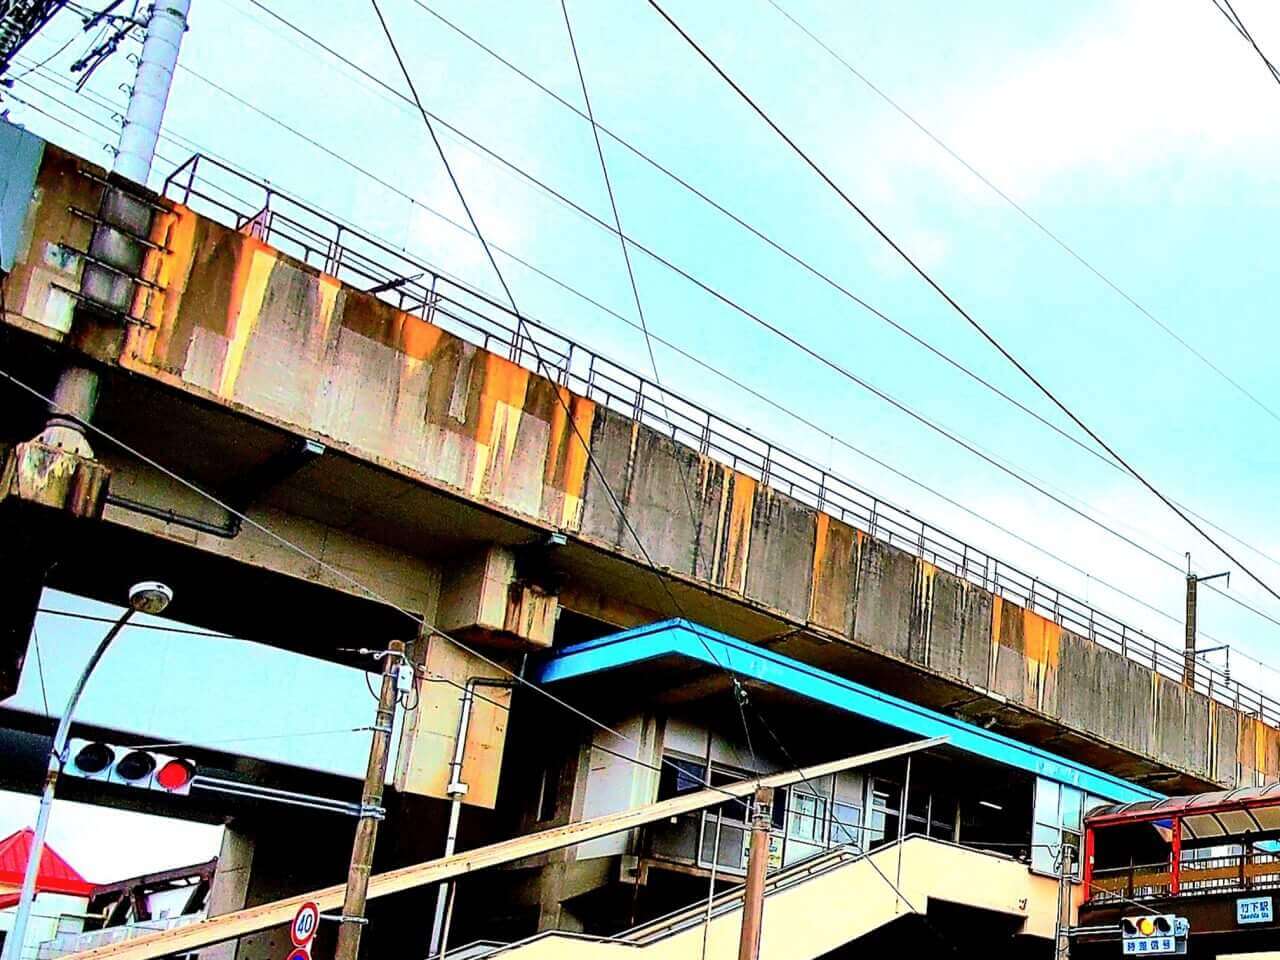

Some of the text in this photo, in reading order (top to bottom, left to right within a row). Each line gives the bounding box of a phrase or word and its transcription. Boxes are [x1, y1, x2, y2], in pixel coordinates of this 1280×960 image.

[1240, 901, 1269, 913] 竹下駅
[297, 914, 312, 933] 40
